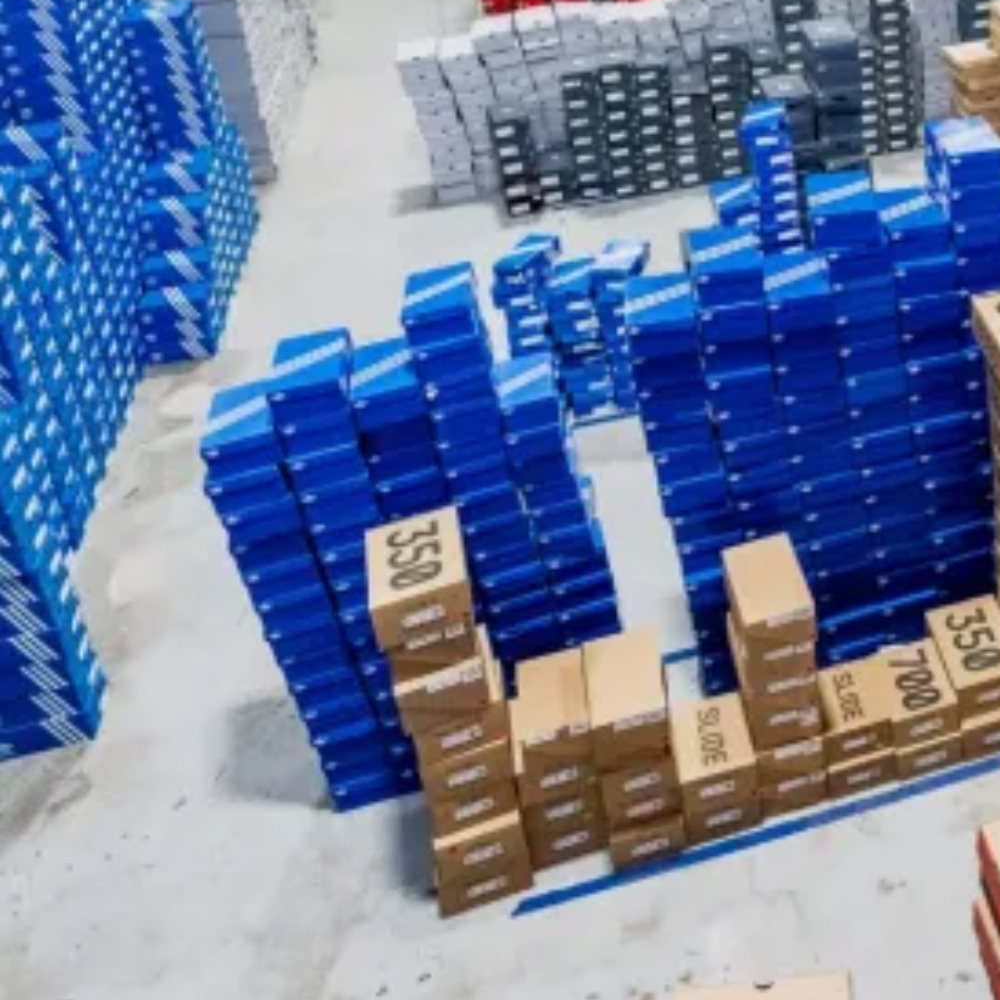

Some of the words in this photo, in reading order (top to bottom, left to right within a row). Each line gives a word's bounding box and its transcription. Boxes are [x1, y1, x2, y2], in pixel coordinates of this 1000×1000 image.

[385, 520, 442, 591] 350
[832, 672, 864, 724] SLIDE
[887, 648, 942, 712] 700
[697, 706, 728, 767] SLIDE
